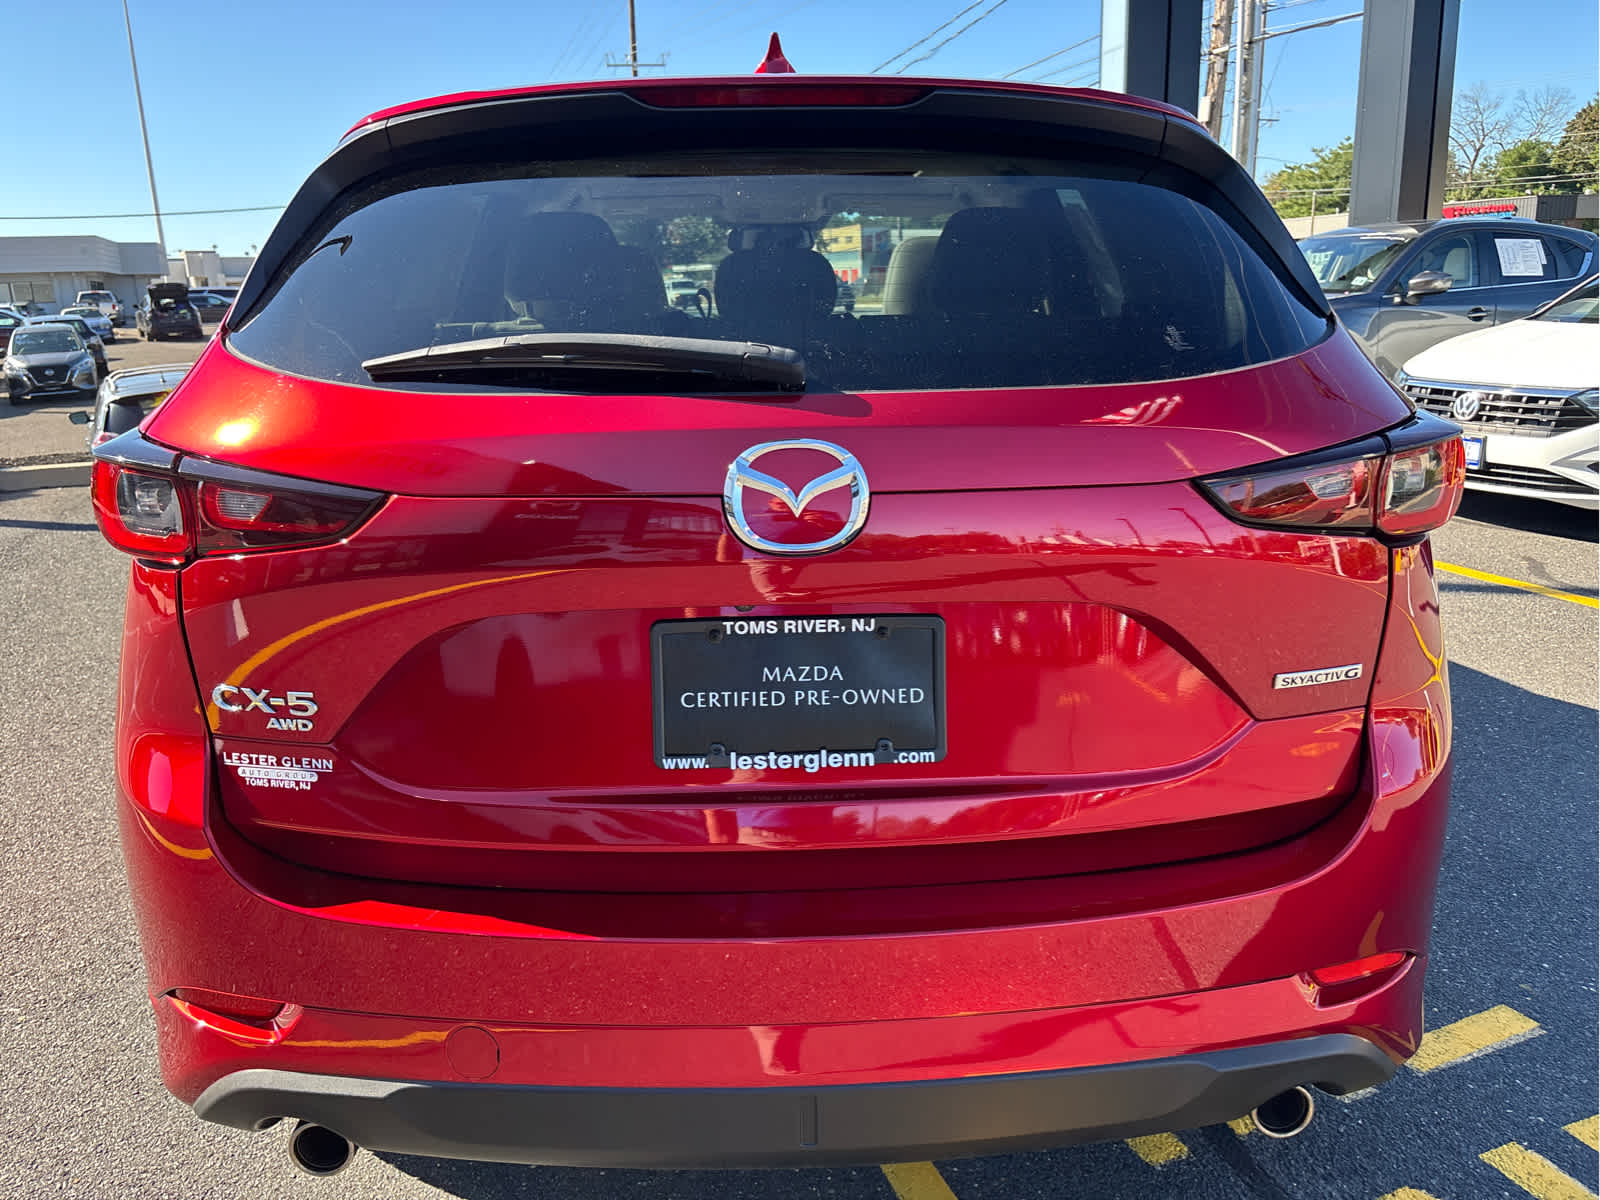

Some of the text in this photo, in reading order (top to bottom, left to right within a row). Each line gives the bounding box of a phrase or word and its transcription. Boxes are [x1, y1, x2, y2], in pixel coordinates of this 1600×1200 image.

[723, 618, 876, 635] TOMS RIVER, NJ
[762, 666, 844, 682] MAZDA
[212, 683, 319, 717] CX-5
[680, 688, 924, 708] CERTIFIED PRE-OWNED
[266, 718, 314, 732] AWD
[223, 752, 333, 770] LESTER GLENN
[663, 750, 935, 773] www. lesterglenn .com
[241, 768, 315, 780] AUTO GROUP
[245, 778, 311, 791] TOMS RIVER, NJ
